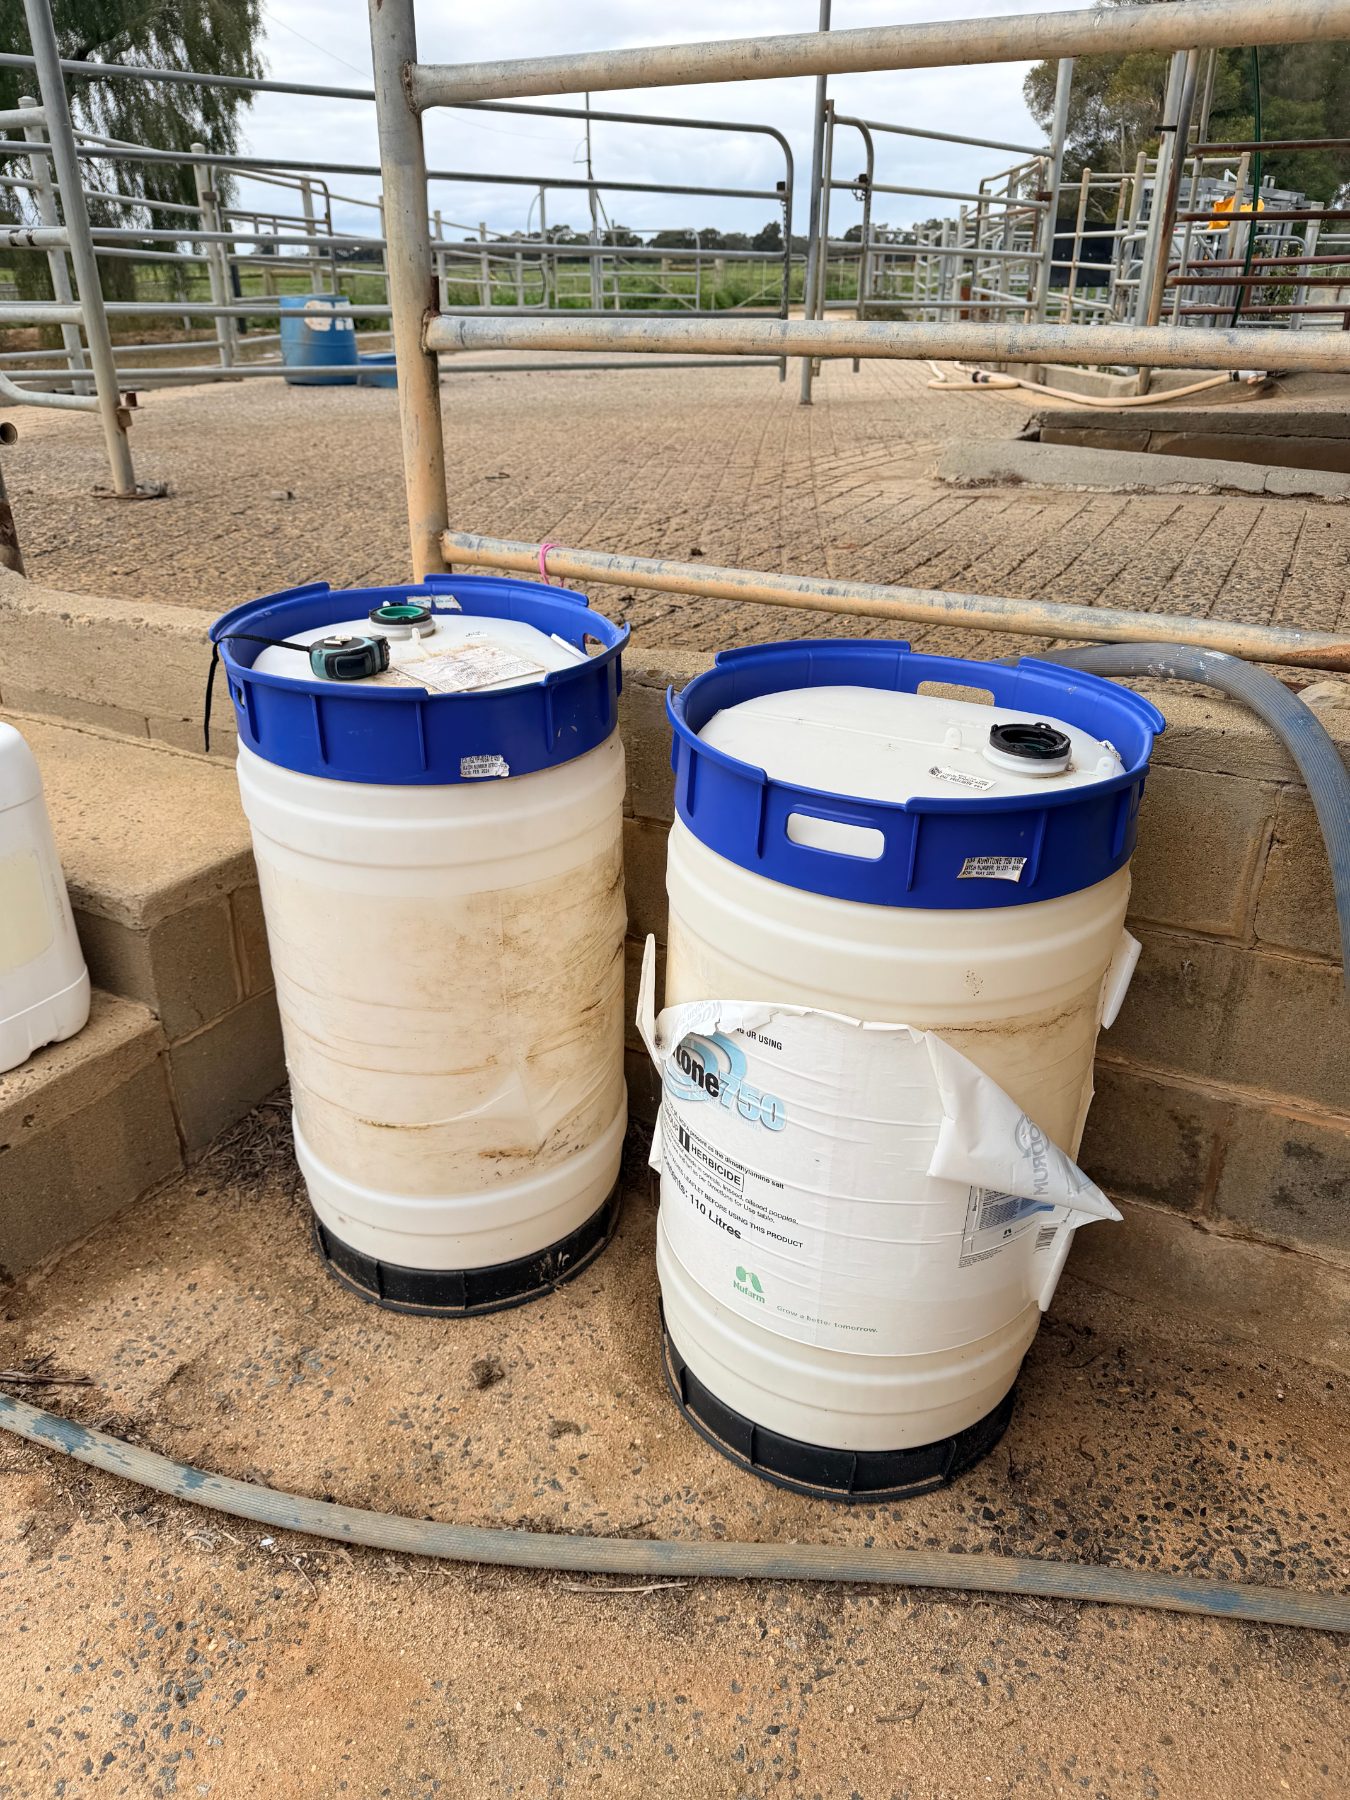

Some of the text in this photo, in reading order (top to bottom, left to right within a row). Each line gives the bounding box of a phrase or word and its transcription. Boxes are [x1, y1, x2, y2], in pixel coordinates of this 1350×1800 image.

[758, 1032, 782, 1051] USING
[719, 1069, 786, 1132] 750
[691, 1143, 741, 1186] HERBICIDE
[725, 1156, 770, 1184] dimethylamine
[771, 1180, 784, 1189] salt
[690, 1194, 706, 1215] 110
[708, 1209, 741, 1239] Litres
[704, 1193, 727, 1213] BEFORE
[728, 1210, 748, 1225] USING
[749, 1222, 766, 1234] THIS
[766, 1230, 803, 1248] PRODUCT
[732, 1280, 766, 1304] Nufarm
[776, 1305, 798, 1317] Grow
